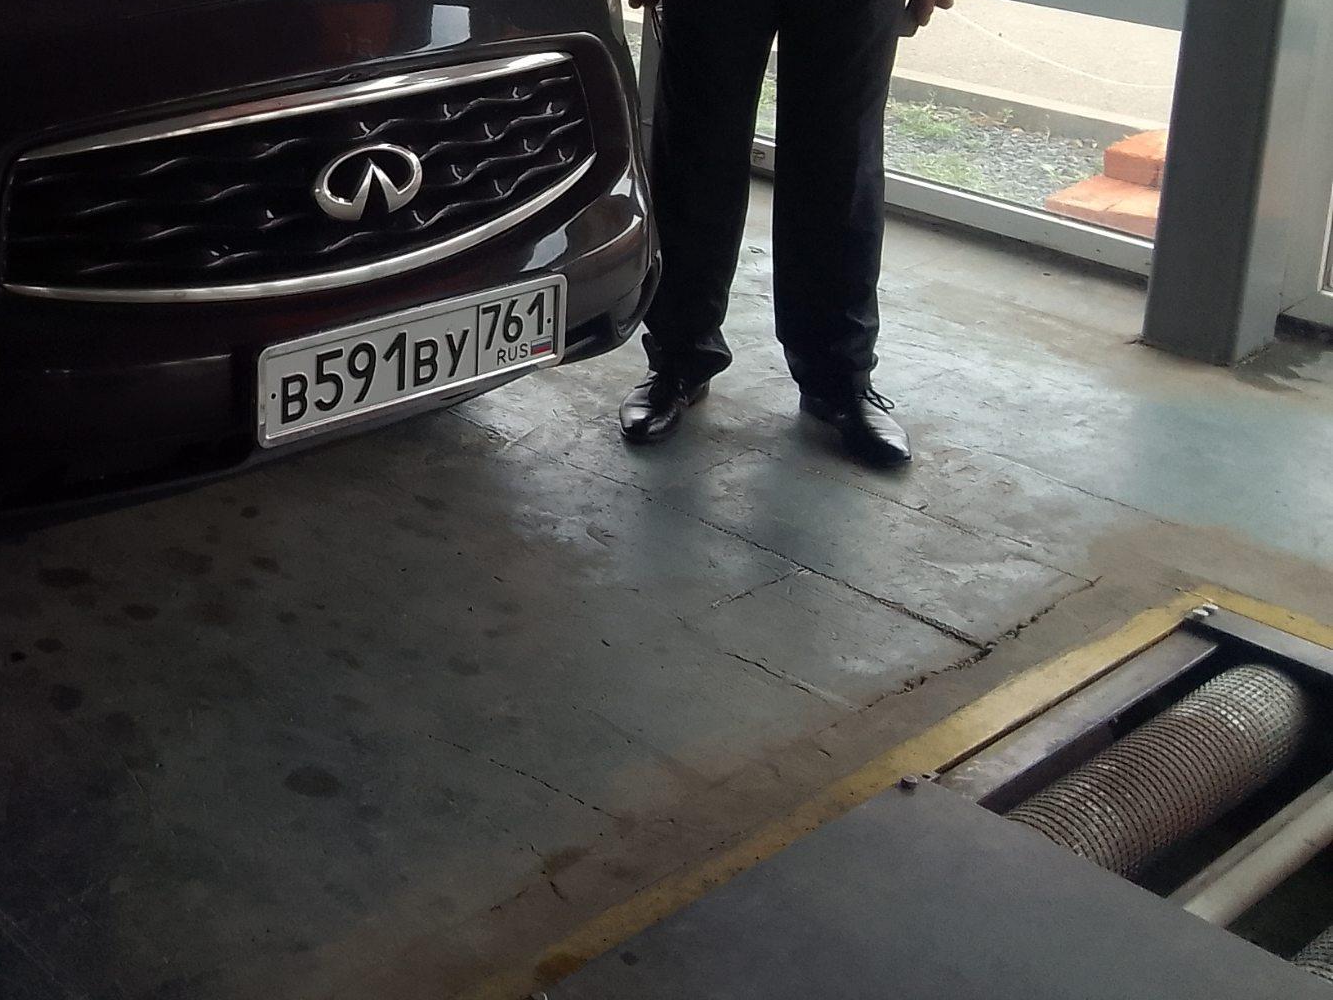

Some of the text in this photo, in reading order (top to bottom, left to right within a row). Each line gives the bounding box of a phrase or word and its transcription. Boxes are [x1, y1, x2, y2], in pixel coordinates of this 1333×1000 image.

[281, 292, 545, 424] В591ВУ 761
[496, 343, 528, 366] RUS
